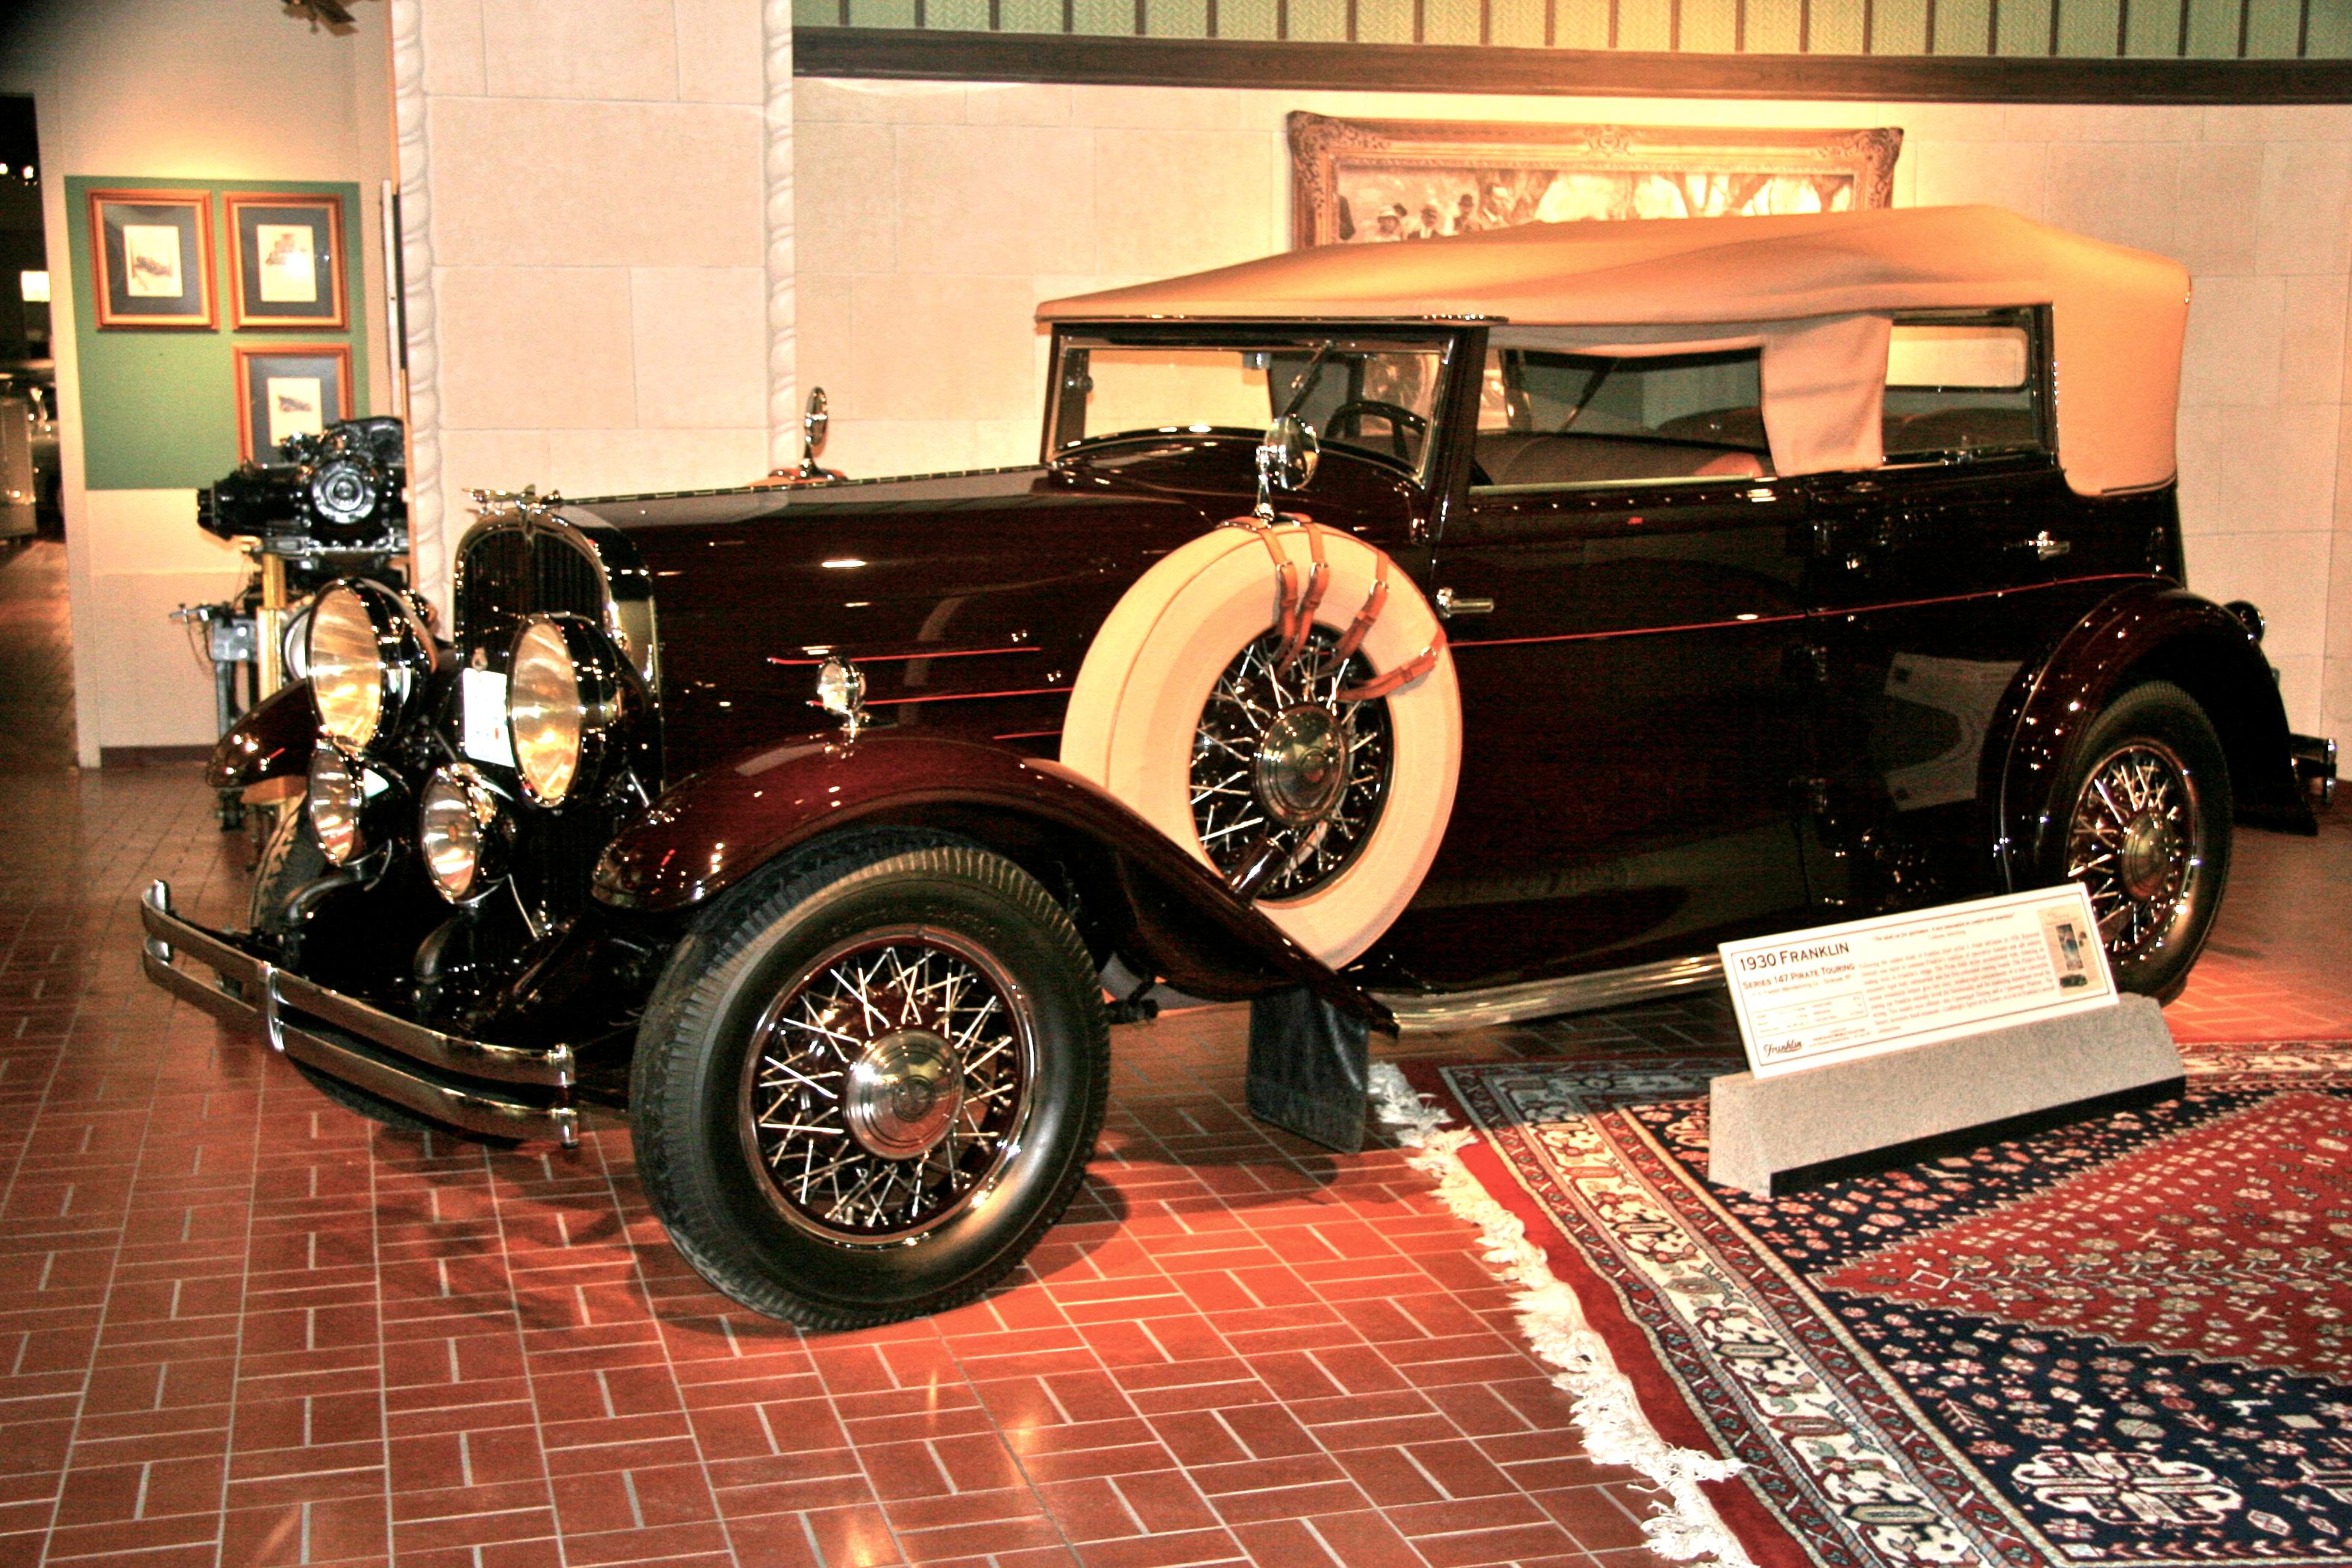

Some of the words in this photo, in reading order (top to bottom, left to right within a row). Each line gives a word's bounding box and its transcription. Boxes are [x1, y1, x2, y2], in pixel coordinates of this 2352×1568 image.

[1740, 953, 1776, 971] 1930
[1780, 942, 1849, 965] FRANKLIN
[1743, 978, 1772, 990] SERIES
[1775, 973, 1788, 983] 147
[1790, 970, 1819, 980] PIRATE
[1821, 964, 1855, 975] TOURING
[1763, 1039, 1802, 1057] Franklin
